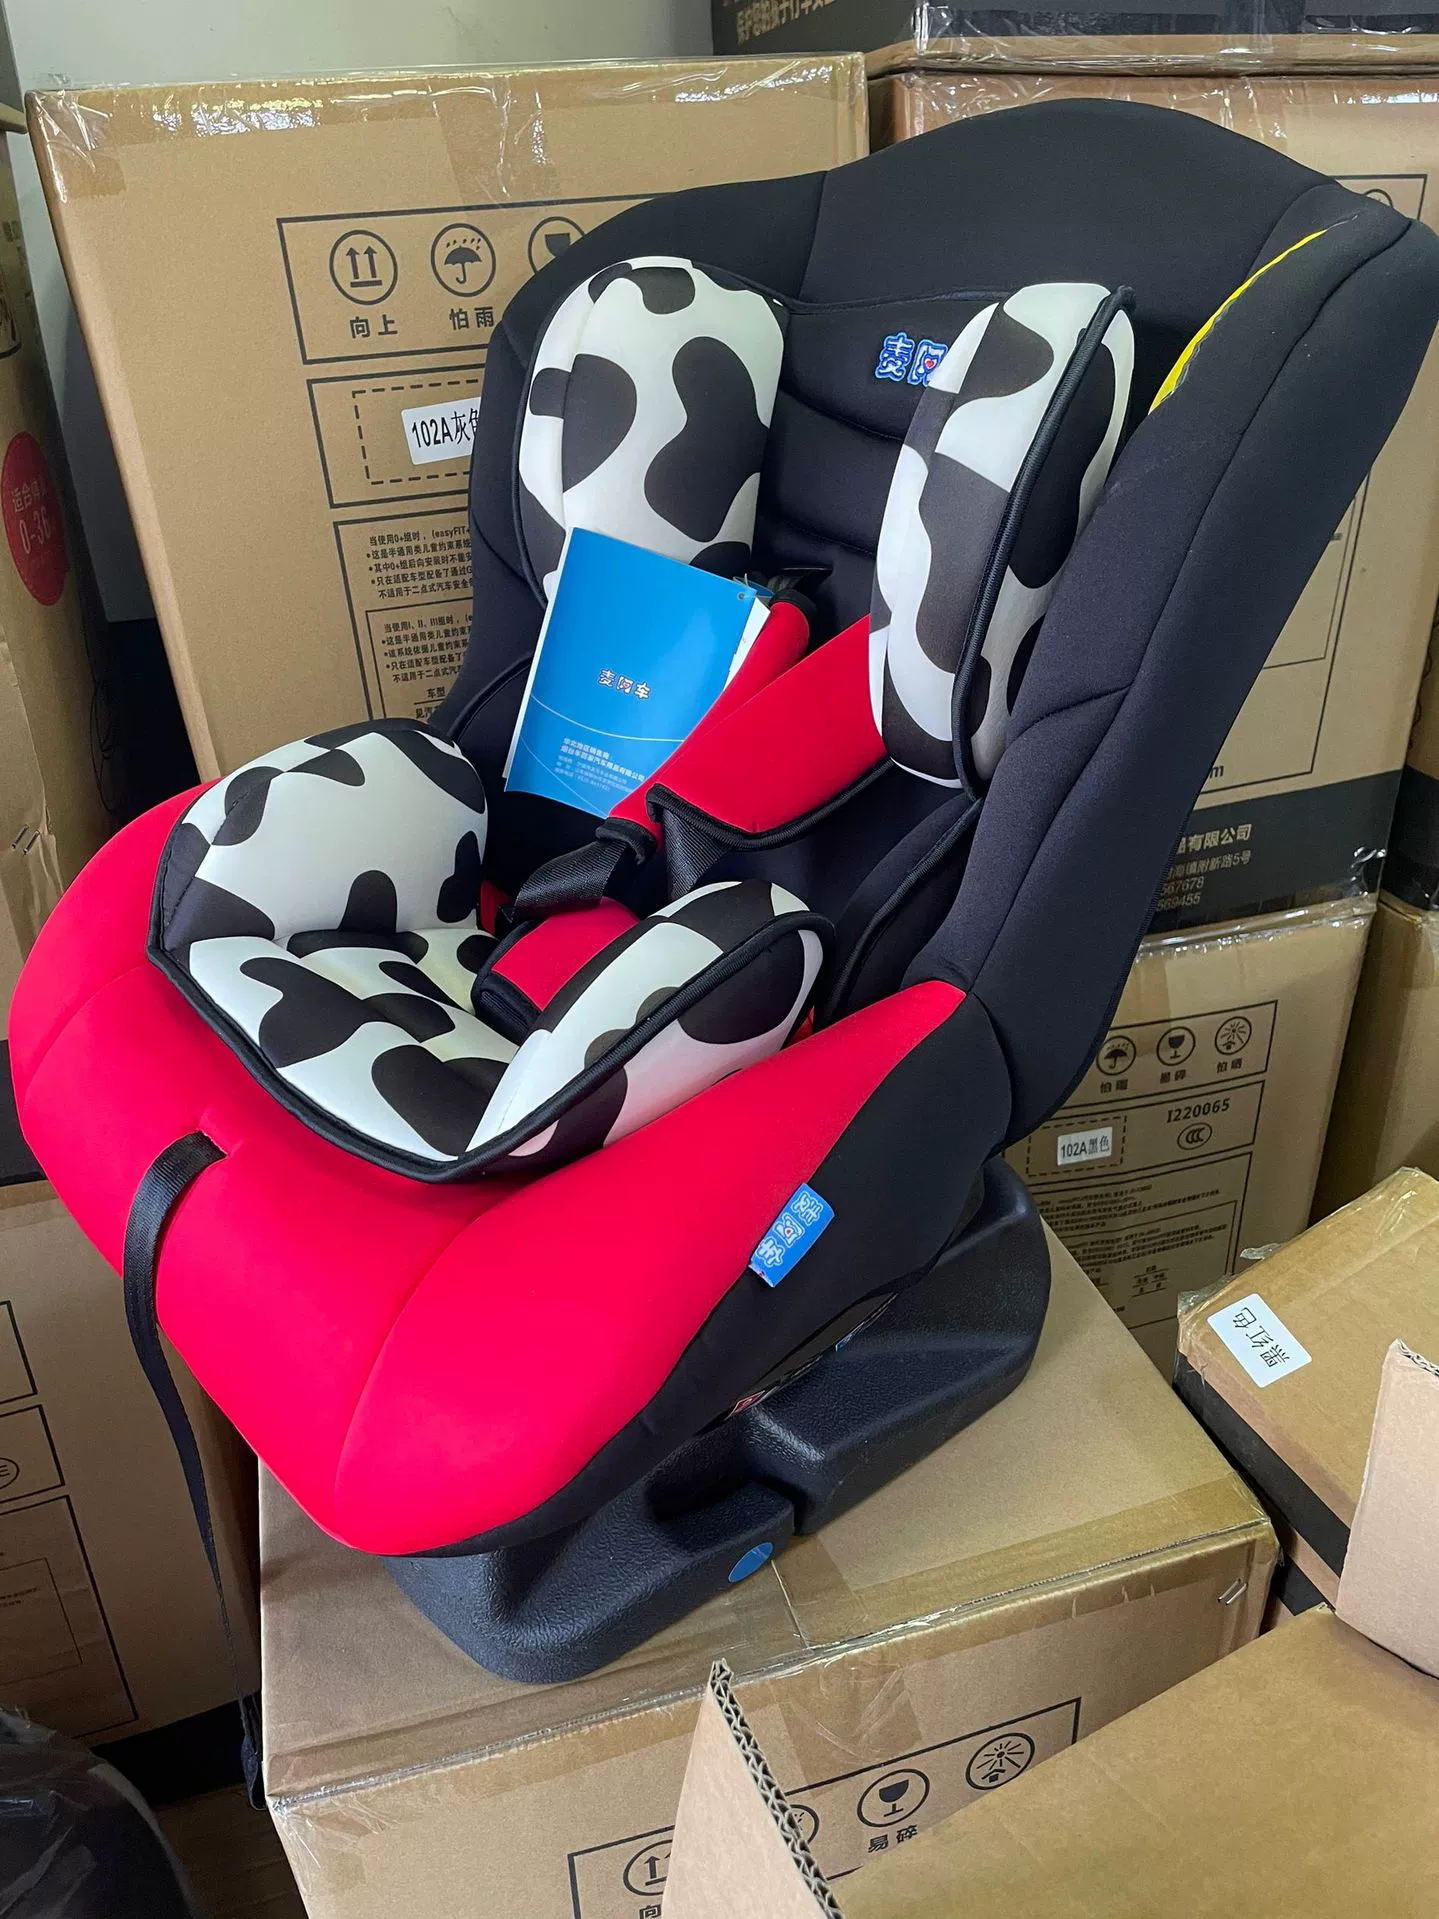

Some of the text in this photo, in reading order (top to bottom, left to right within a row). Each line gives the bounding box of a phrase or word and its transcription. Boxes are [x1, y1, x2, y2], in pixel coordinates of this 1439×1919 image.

[350, 314, 398, 339] 向上
[449, 306, 494, 330] 怕雨
[1166, 1098, 1231, 1123] I220065
[1060, 1135, 1110, 1159] 102A黑色
[1232, 1307, 1290, 1368] 黑红色
[868, 1824, 918, 1853] 易碎
